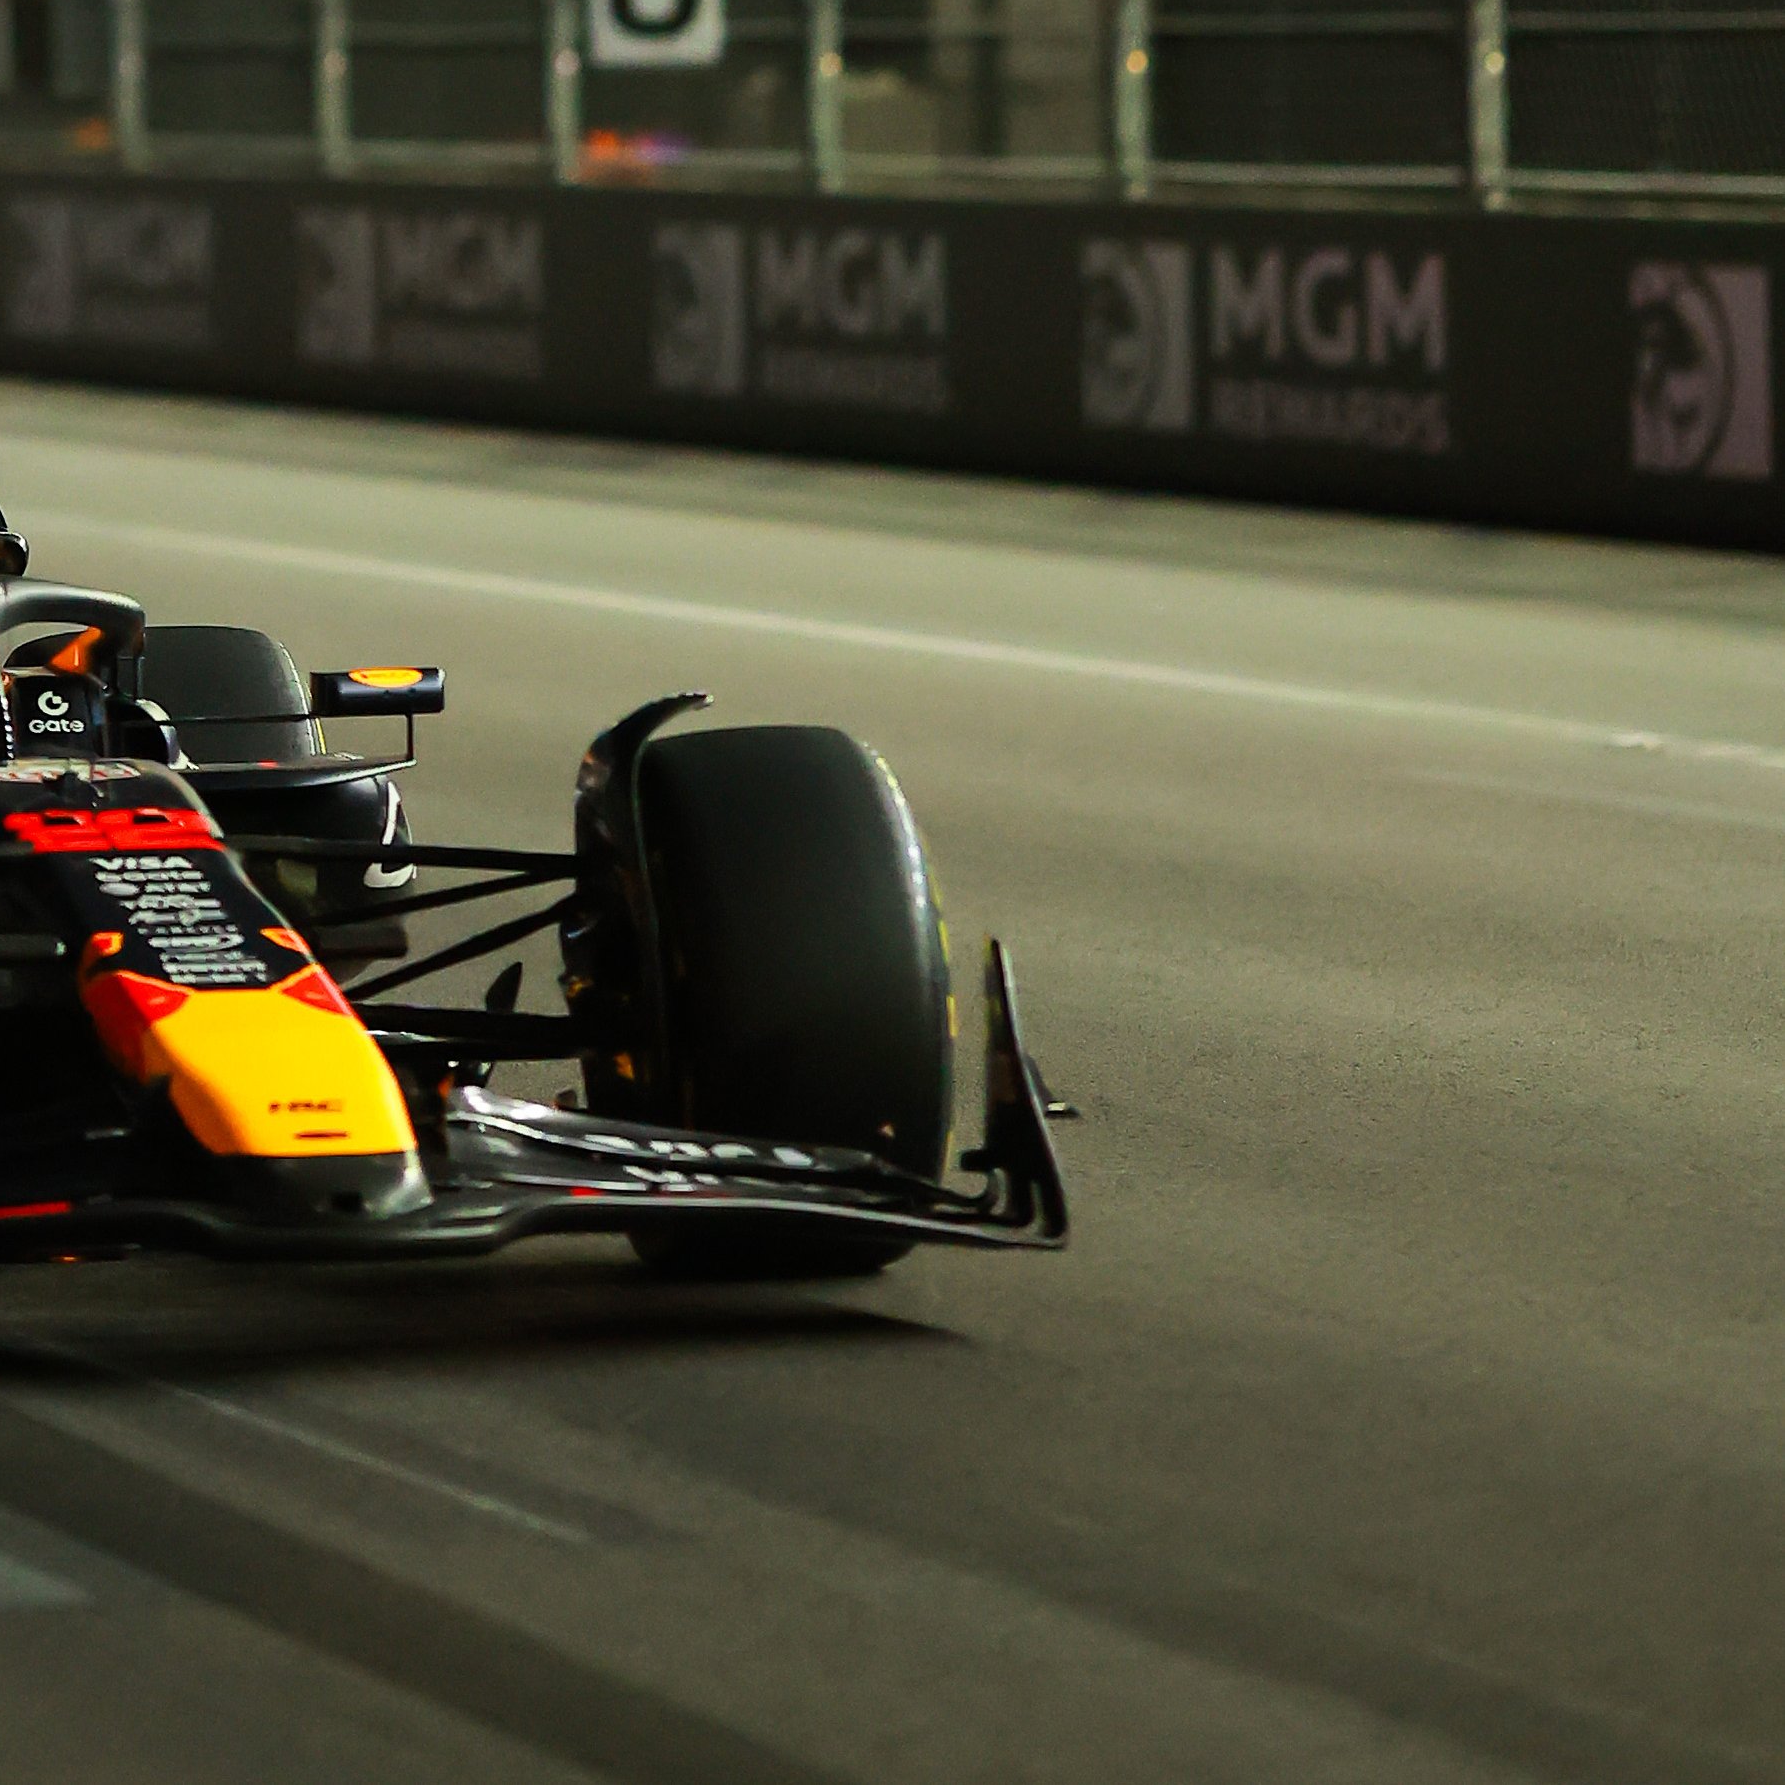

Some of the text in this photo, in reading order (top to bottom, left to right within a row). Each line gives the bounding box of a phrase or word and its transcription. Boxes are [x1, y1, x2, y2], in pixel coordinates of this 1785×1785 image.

[757, 225, 946, 335] MGM
[1208, 246, 1448, 371] MGM
[28, 718, 85, 734] Gate
